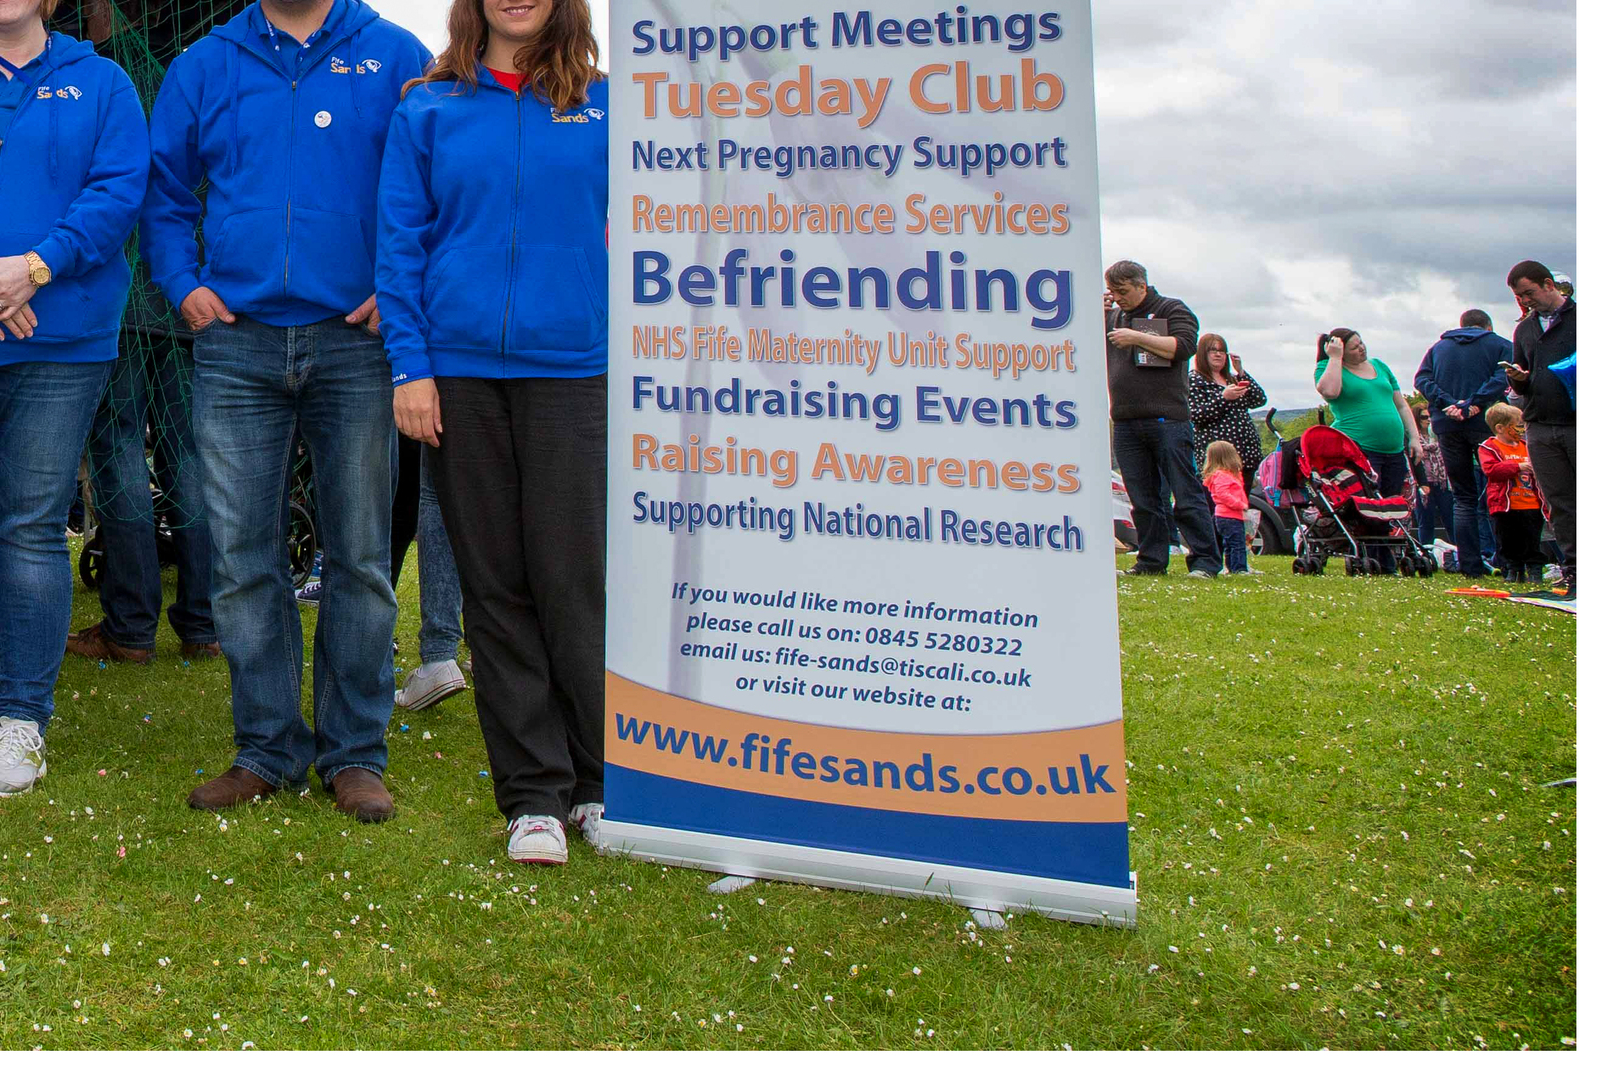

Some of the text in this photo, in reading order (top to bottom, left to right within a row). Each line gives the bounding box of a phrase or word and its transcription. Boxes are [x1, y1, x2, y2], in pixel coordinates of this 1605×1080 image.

[632, 5, 1062, 60] Support Meetings
[551, 113, 590, 123] Sands
[632, 57, 1065, 129] Tuesday Club
[632, 136, 1066, 177] Next Pregnancy Support
[632, 192, 1069, 235] Remembrance Services
[632, 249, 1073, 329] Befriending
[632, 326, 1075, 379] NHS Fife Maternity Unit Support
[632, 375, 1077, 431] Fundraising Events
[632, 433, 1080, 493] Raising Awareness
[632, 491, 1082, 551] Supporting National Research
[672, 582, 1039, 628] If you would like more information
[686, 613, 1023, 657] please call us on: 0845 5280322
[680, 641, 1032, 688] email us: fife-sands@tiscali.co.uk
[736, 675, 972, 711] or visit our website at:
[615, 712, 1116, 795] www.fifesands.co.uk
